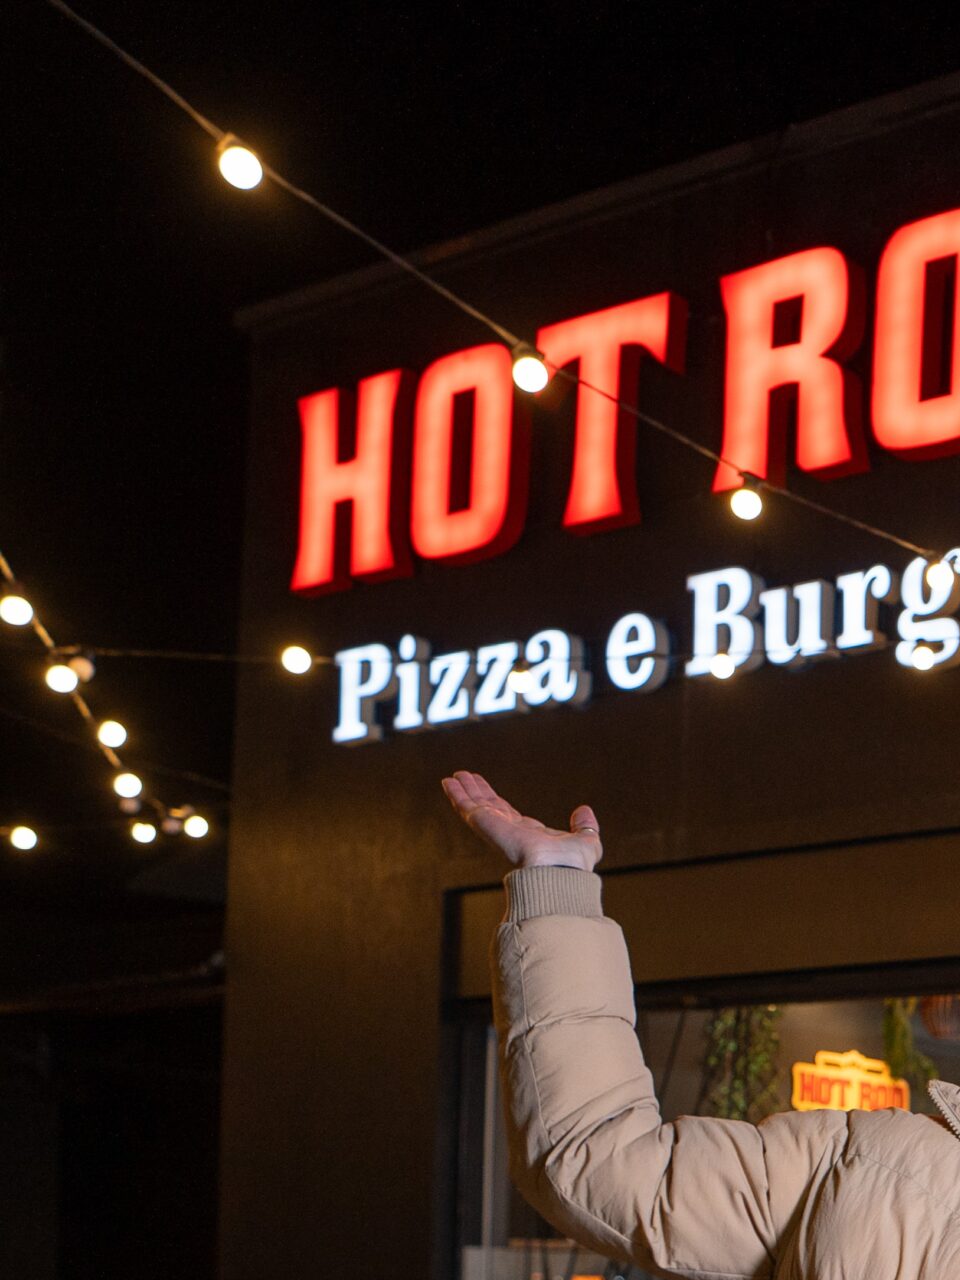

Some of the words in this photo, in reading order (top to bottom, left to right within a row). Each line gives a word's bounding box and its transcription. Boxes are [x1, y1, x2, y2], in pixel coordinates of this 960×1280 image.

[290, 291, 673, 594] HOT
[332, 629, 579, 744] Pizza
[606, 613, 659, 691] e
[800, 1073, 850, 1107] HOT
